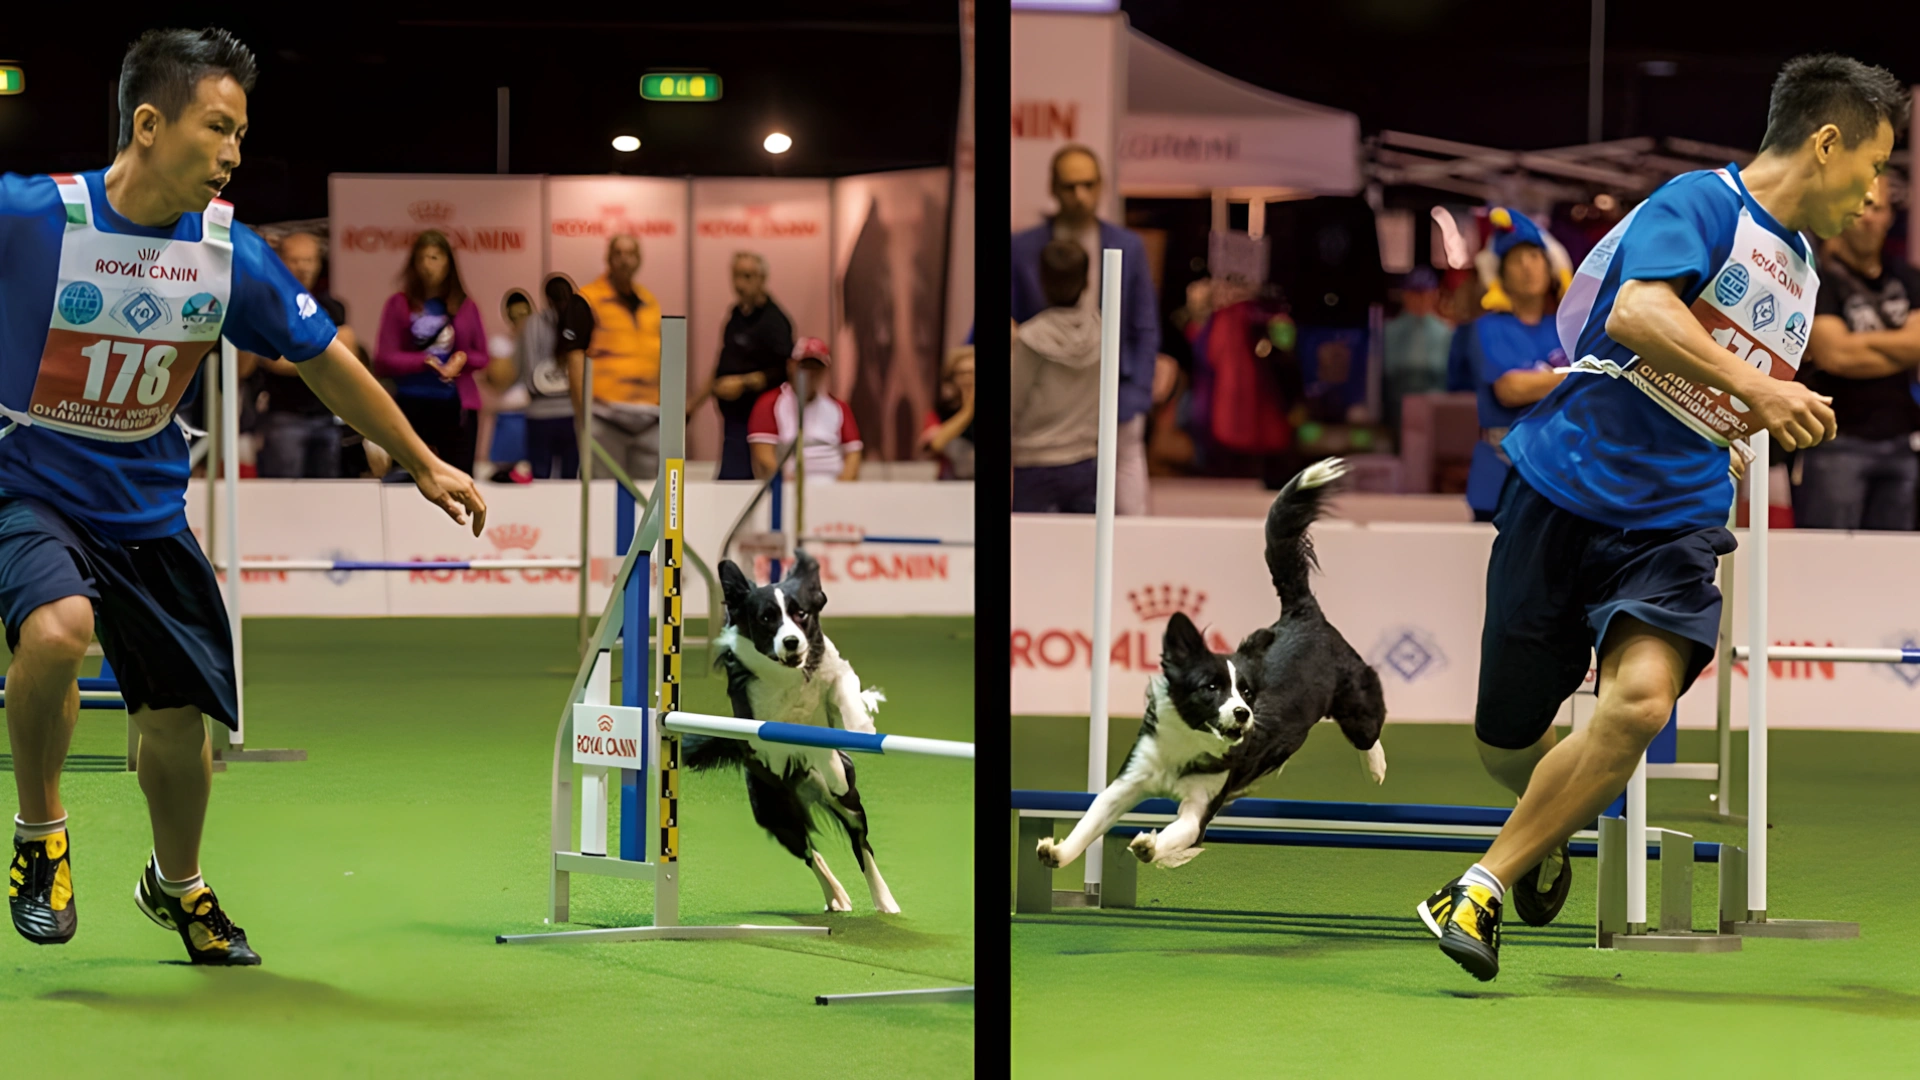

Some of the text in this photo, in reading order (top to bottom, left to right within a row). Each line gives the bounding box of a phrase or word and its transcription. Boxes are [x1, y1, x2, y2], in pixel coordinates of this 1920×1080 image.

[343, 227, 416, 253] ROYA
[95, 259, 198, 282] ROYAL CANIN
[81, 339, 178, 406] 178
[1664, 372, 1715, 408] AGILITY
[58, 400, 120, 418] AGILITY
[846, 555, 948, 581] CANIN
